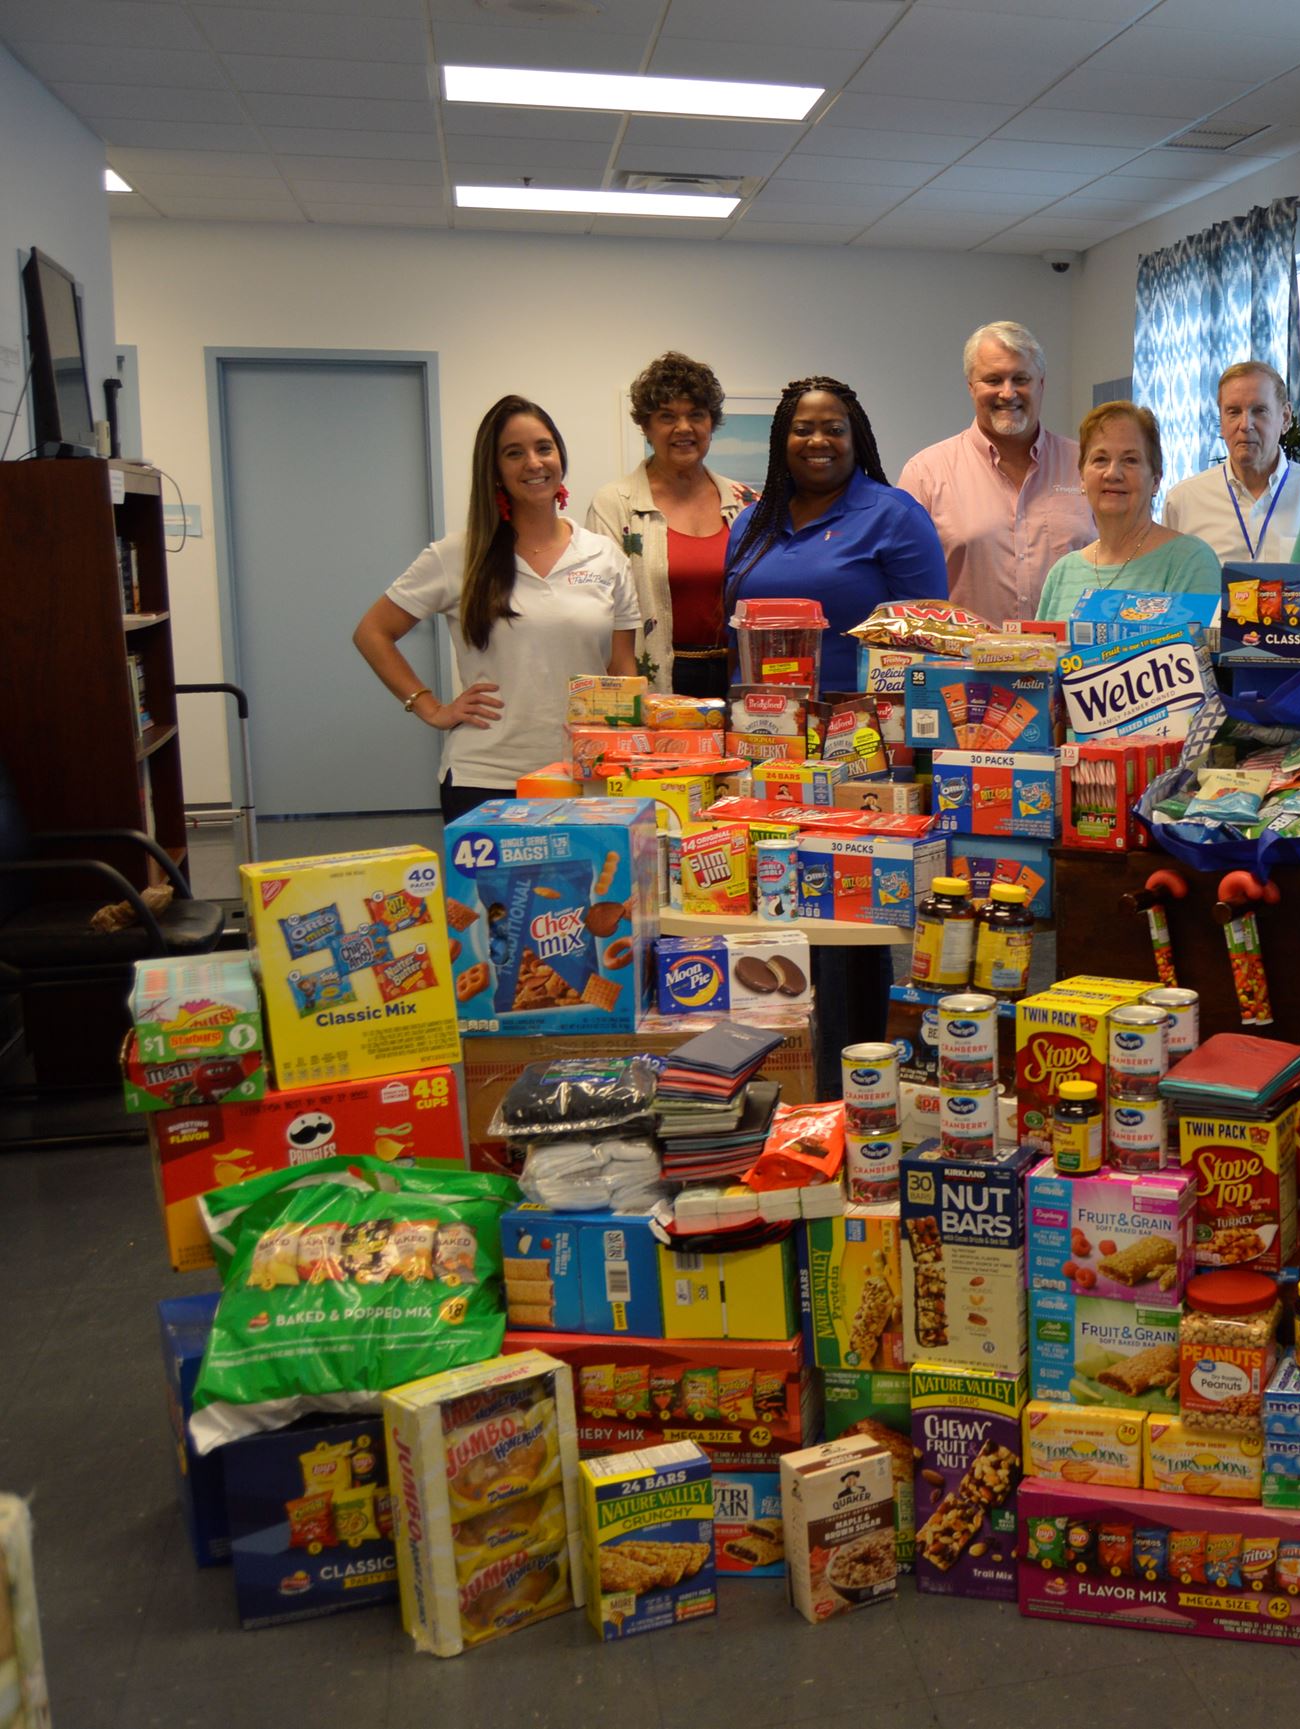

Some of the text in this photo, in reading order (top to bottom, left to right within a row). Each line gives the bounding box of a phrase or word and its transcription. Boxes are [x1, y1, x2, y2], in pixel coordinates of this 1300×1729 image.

[1060, 655, 1083, 675] 90
[913, 672, 924, 680] 36
[1012, 679, 1045, 689] Austin
[570, 680, 594, 693] Lance
[1071, 652, 1194, 722] Welch's
[1099, 690, 1176, 726] FAMILY FARMER OWNED
[1118, 710, 1167, 736] MIXED FRUIT
[970, 755, 1015, 765] 30 PACKS
[609, 781, 623, 792] 12
[501, 836, 549, 850] SINGLE SERVE
[681, 831, 731, 852] 14 ORIGINAL
[831, 843, 874, 854] 30 PACKS
[454, 839, 497, 868] 42
[502, 848, 549, 861] BAGS!
[408, 868, 435, 882] 40
[409, 881, 435, 889] PACKS
[530, 905, 586, 940] Chex
[665, 964, 703, 989] Moon
[689, 974, 712, 991] Pie
[316, 1001, 416, 1027] Classic Mix
[1023, 1006, 1077, 1026] TWIN PACK
[169, 1032, 222, 1048] Starburst
[1024, 1031, 1090, 1085] Stove
[413, 1077, 449, 1098] 48
[845, 1092, 890, 1101] CRANBERRY
[417, 1097, 449, 1109] CUPS
[169, 1131, 210, 1144] FLAVOR
[1185, 1121, 1247, 1140] TWIN PACK
[944, 1169, 986, 1179] KIRKLAND
[1198, 1152, 1262, 1196] Stove
[909, 1177, 933, 1191] 30
[942, 1184, 1010, 1212] NUT
[1214, 1180, 1252, 1209] Top
[942, 1213, 1012, 1237] BARS
[1216, 1215, 1253, 1228] TURKEY
[276, 1306, 433, 1328] BAKED & POPPED MIX
[1182, 1344, 1262, 1366] PEANUTS
[915, 1376, 1011, 1401] NATURE VALLEY
[1201, 1378, 1242, 1391] Peanuts
[577, 1429, 644, 1440] IERY MIX
[671, 1431, 734, 1442] MEGA SIZE
[752, 1430, 769, 1442] 42
[924, 1415, 991, 1440] CHEWY
[446, 1418, 517, 1480] JUMBO
[937, 1452, 970, 1468] NUT
[621, 1470, 687, 1494] 24 BARS
[601, 1483, 709, 1526] NATURE VALLEY
[833, 1492, 871, 1511] QUAKER
[622, 1507, 692, 1530] CRUNCHY
[824, 1517, 881, 1541] BROWN SUGAR
[350, 1574, 382, 1587] PARTY
[973, 1569, 1013, 1581] Trail Mix
[1079, 1583, 1167, 1604] FLAVOR MIX
[610, 1597, 634, 1610] MORE
[1186, 1596, 1251, 1610] MEGA SIZE
[1271, 1601, 1287, 1614] 42
